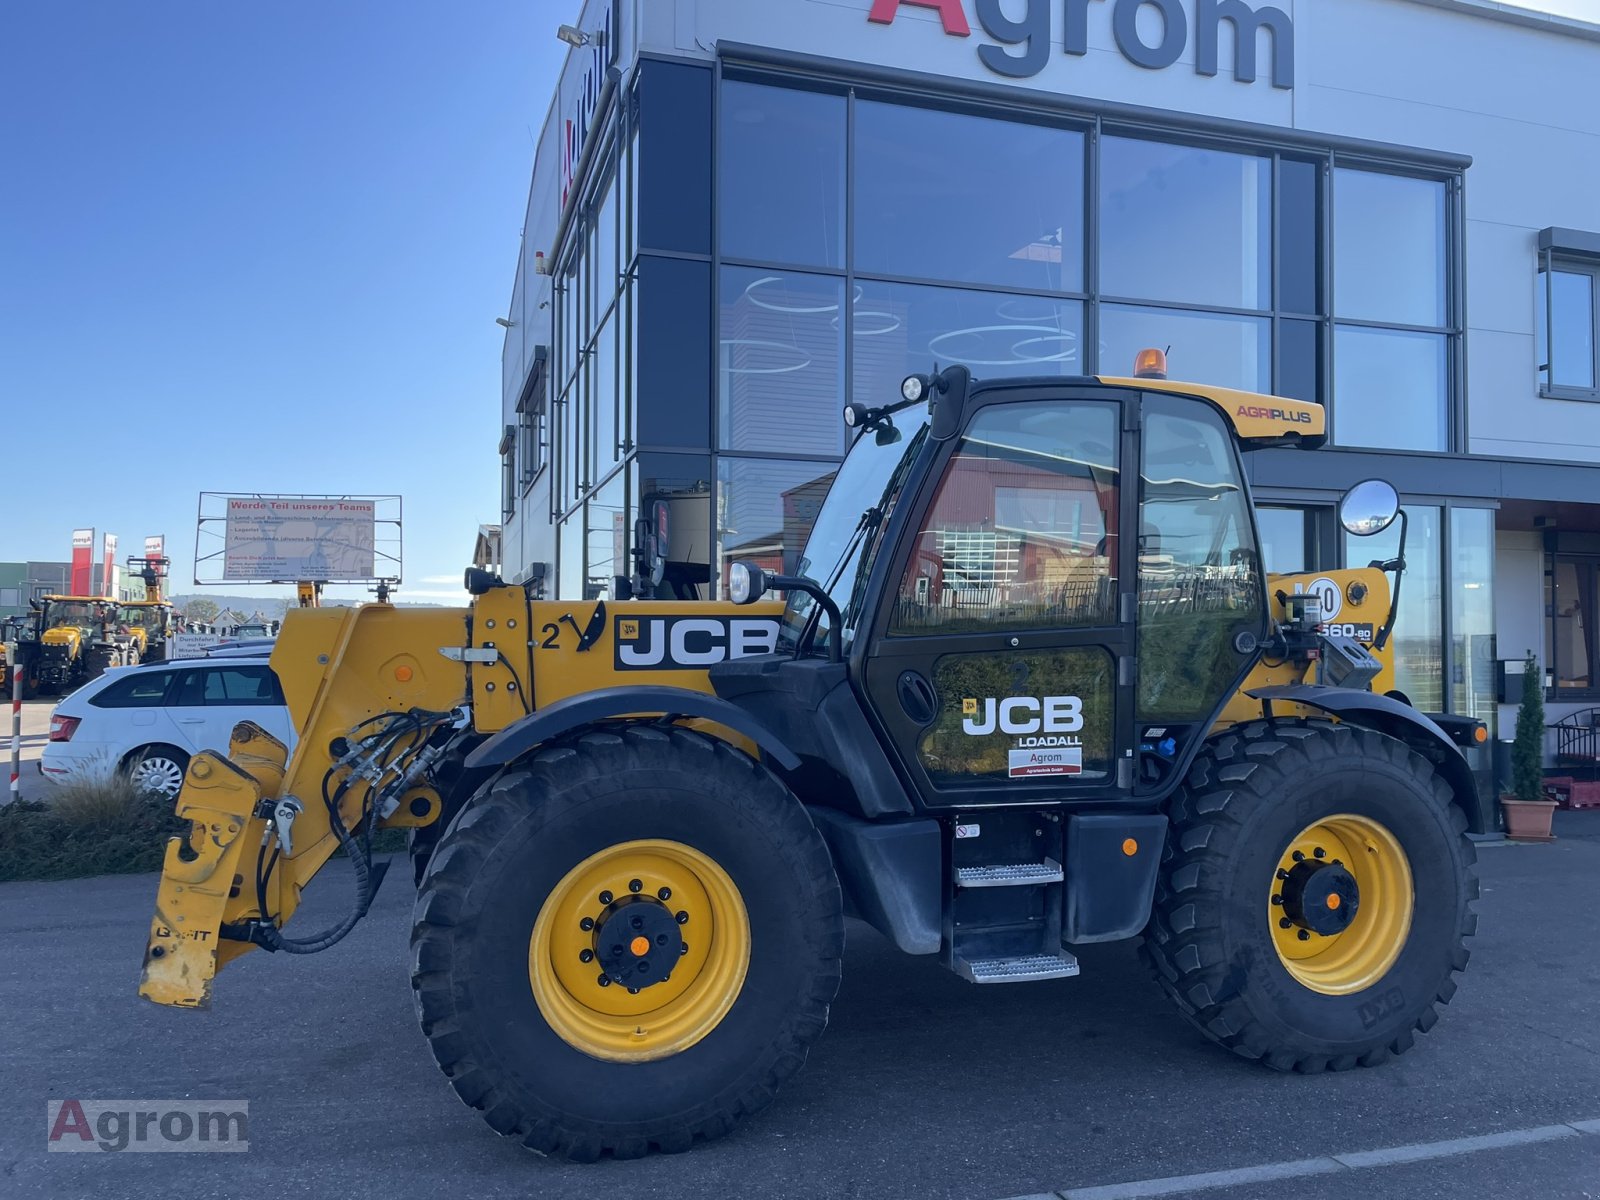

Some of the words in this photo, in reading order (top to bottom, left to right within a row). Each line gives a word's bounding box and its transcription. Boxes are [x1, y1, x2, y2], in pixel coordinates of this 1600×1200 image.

[1236, 405, 1312, 424] AGRIPLUS
[231, 501, 267, 510] Werde
[270, 502, 289, 510] Teil
[292, 502, 335, 511] unseres
[338, 503, 372, 512] Teams
[541, 623, 561, 649] 2
[619, 619, 781, 666] JCB
[963, 696, 1084, 735] JCB
[1019, 736, 1083, 748] LOADALL
[1030, 753, 1062, 764] Agrom
